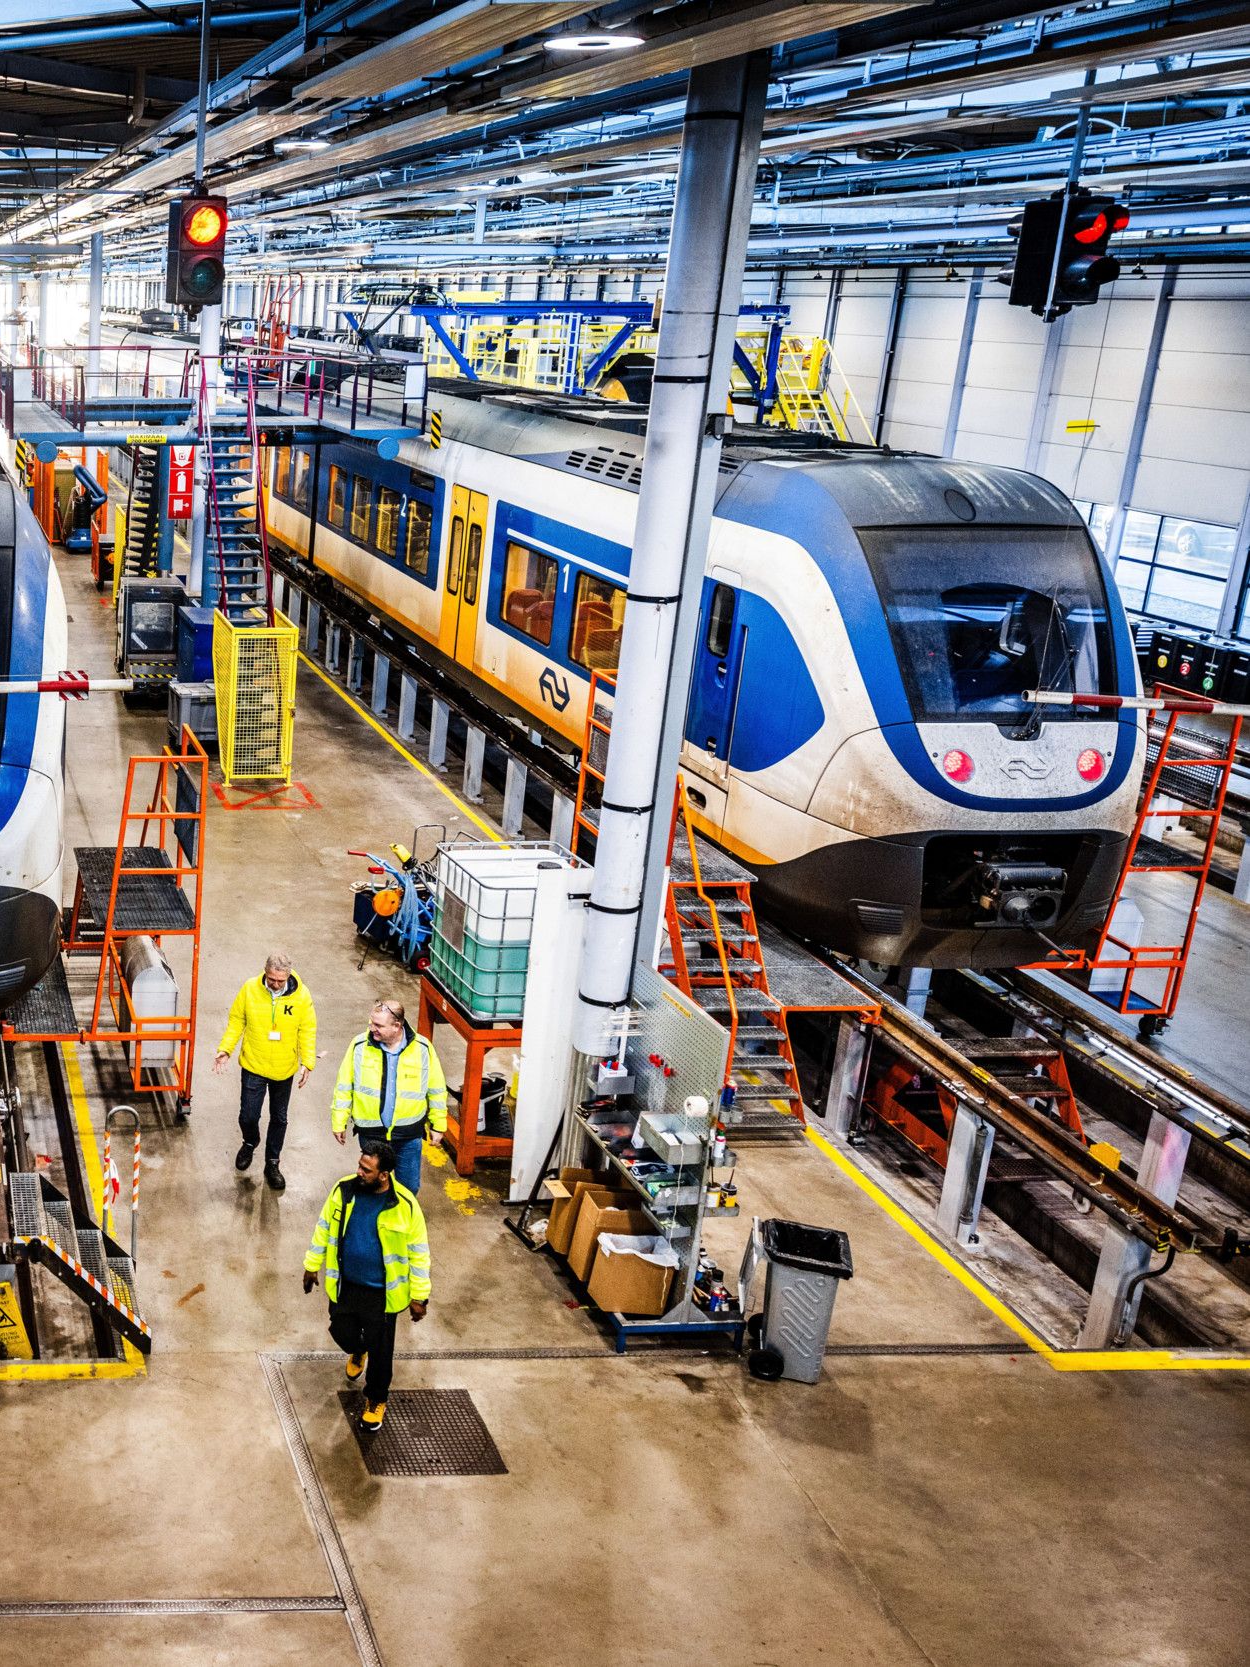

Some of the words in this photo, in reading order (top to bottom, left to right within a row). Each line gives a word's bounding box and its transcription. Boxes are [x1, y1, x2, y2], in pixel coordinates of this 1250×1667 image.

[400, 494, 408, 517] 2
[562, 563, 570, 593] 1
[284, 1004, 294, 1016] K
